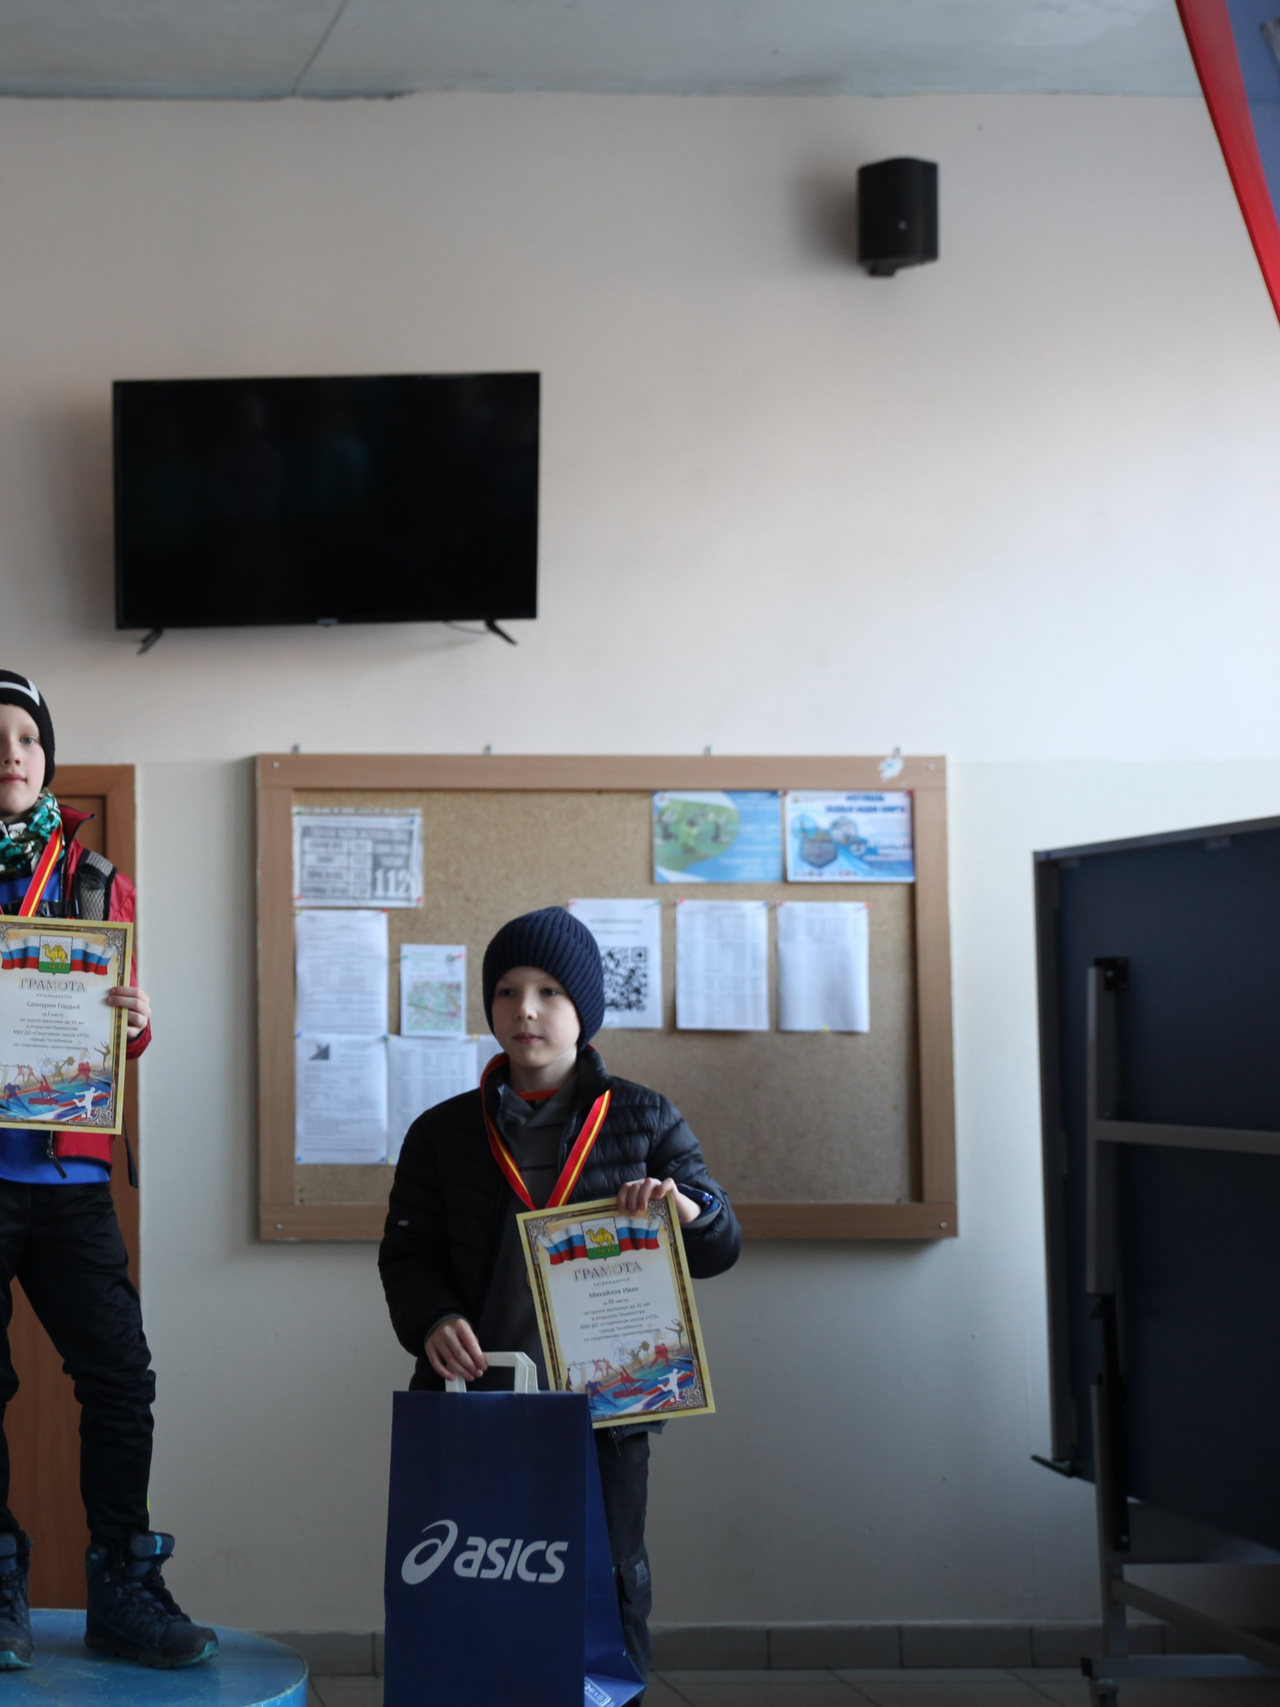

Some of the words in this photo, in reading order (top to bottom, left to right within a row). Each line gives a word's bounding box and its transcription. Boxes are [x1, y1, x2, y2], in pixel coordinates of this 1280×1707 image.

[374, 868, 411, 898] 112
[20, 978, 86, 992] ГРАМОТА
[573, 1261, 642, 1281] ГРАМОТА
